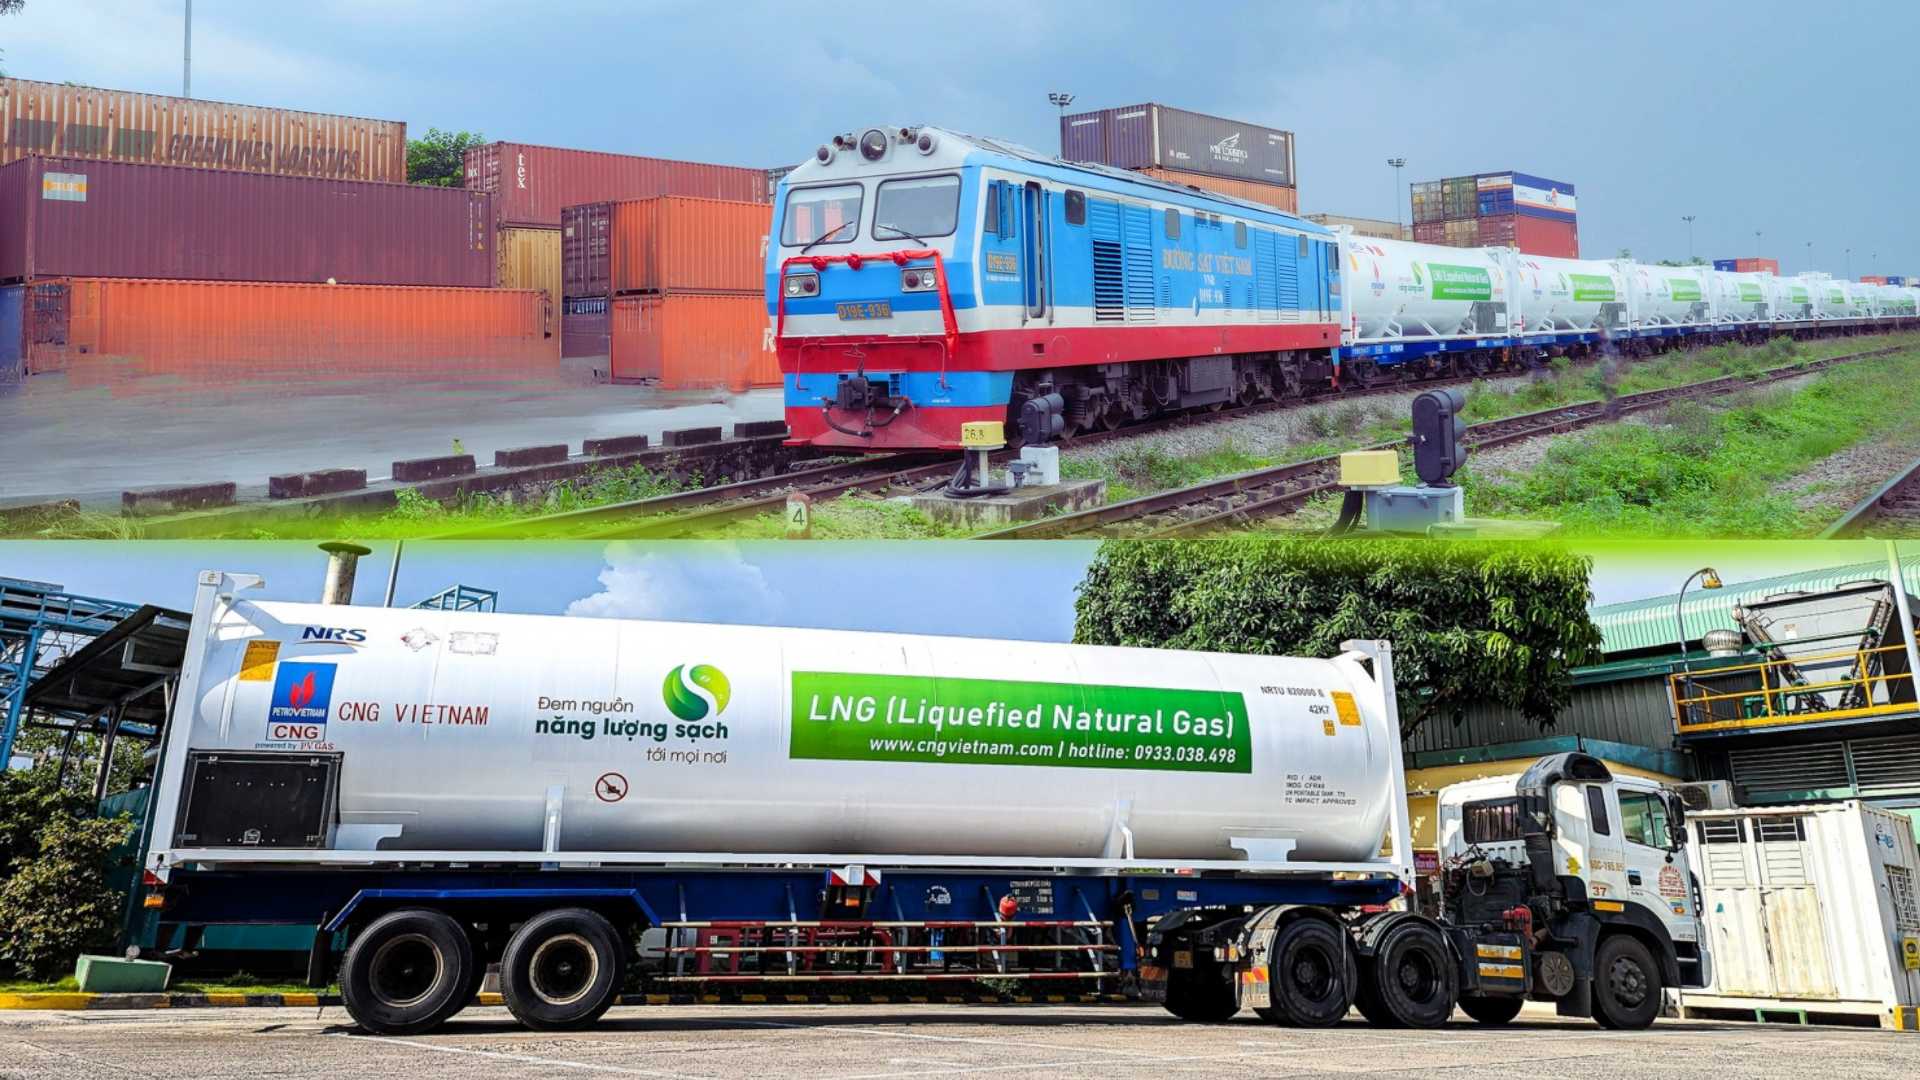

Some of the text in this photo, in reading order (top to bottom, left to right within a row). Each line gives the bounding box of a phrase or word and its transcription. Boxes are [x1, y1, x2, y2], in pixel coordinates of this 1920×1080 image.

[792, 507, 805, 526] 4
[302, 626, 367, 642] NRS
[272, 706, 326, 718] PETROVIETNAM
[538, 696, 634, 714] Đem nguồn
[338, 702, 489, 726] CNG VIETNAM
[809, 694, 1234, 739] LNG (Liquefied Natural Gas)
[274, 725, 318, 739] CNG
[535, 715, 729, 743] năng lượng sạch
[255, 742, 286, 750] powered
[869, 738, 1053, 757] www.cngvietnam.com
[1068, 741, 1130, 760] hotline:
[1134, 745, 1237, 764] 0933.038.498
[647, 748, 727, 765] tới mọi nơi
[1592, 886, 1607, 896] 37
